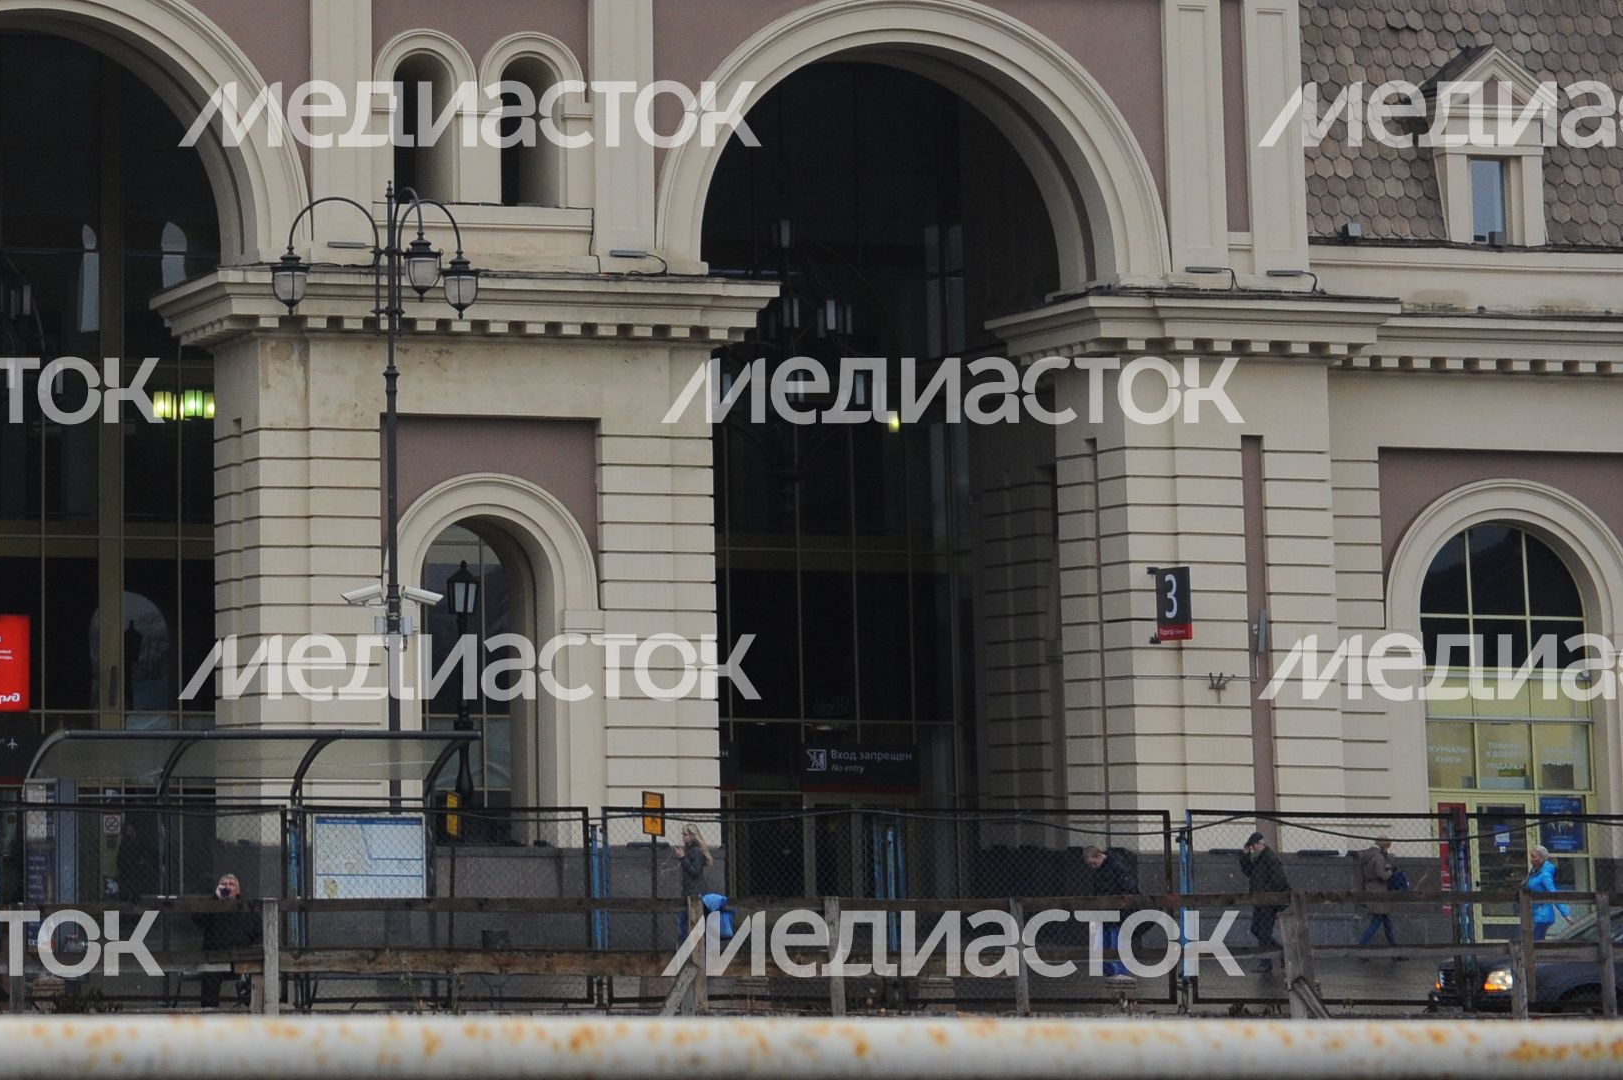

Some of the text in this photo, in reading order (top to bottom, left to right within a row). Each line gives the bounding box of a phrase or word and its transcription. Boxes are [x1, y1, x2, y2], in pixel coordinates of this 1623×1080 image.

[1165, 574, 1178, 619] 3
[831, 749, 913, 762] Вход запрещен
[831, 764, 865, 774] No entry
